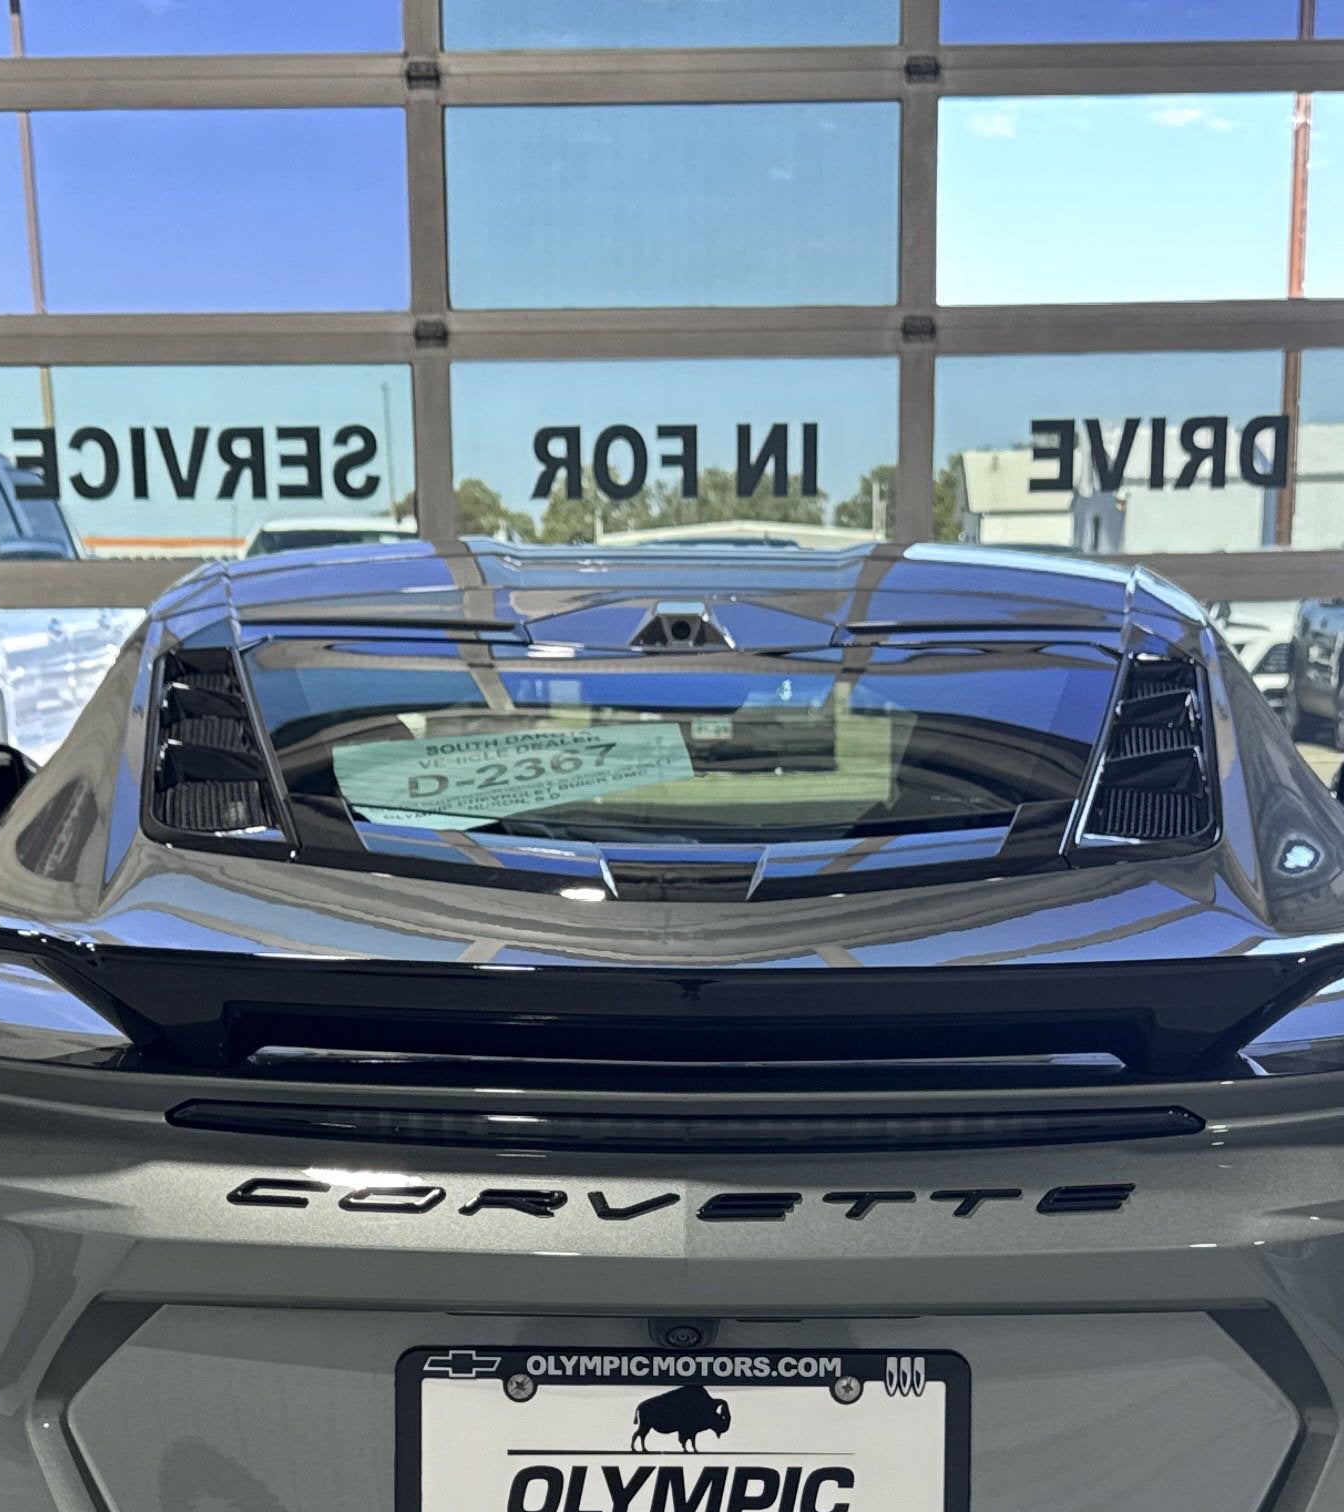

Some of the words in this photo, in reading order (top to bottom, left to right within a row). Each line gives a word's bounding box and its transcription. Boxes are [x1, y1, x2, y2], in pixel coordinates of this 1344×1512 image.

[425, 738, 498, 756] SOUTH
[516, 735, 601, 754] DEALER
[408, 742, 617, 798] D-2367
[225, 1177, 1136, 1221] CORVETTE
[527, 1355, 842, 1378] OLYMPICMOTORS.COM
